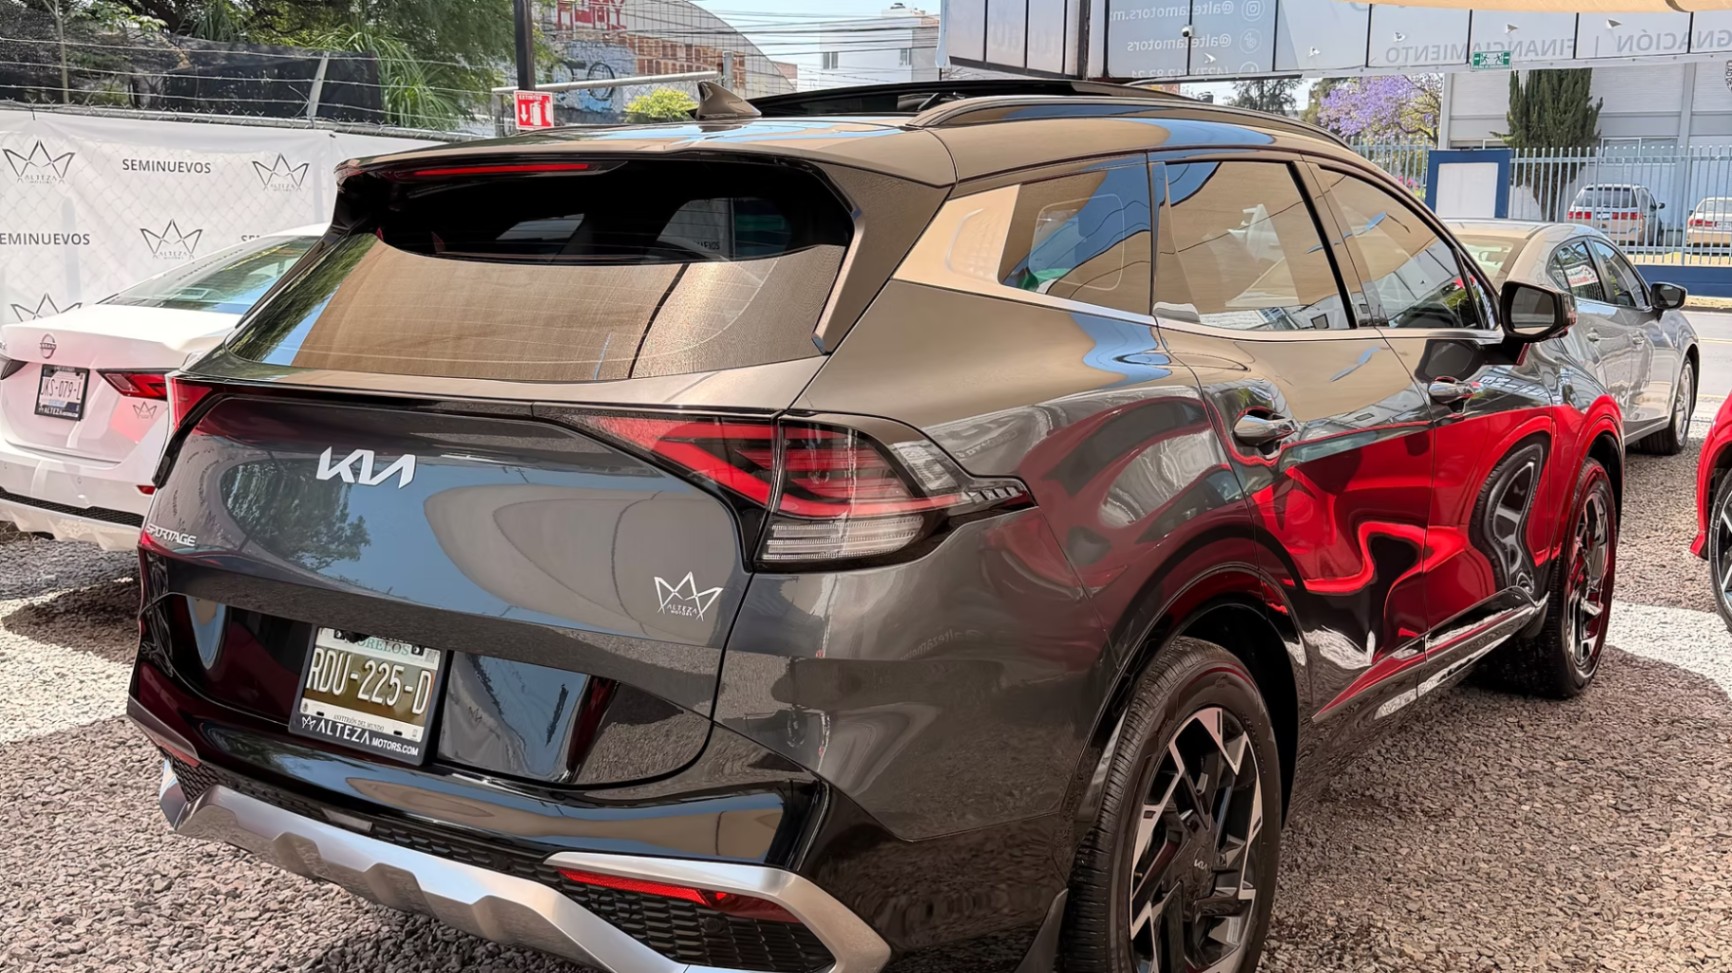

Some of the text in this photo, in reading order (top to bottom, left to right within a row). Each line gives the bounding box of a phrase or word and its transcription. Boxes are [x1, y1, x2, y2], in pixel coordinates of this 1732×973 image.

[122, 158, 211, 174] SEMINUEVOS
[316, 446, 417, 489] KIA
[667, 604, 698, 614] ALTEZA
[345, 637, 410, 656] ORELOS
[306, 647, 432, 715] RDU-225-D
[316, 719, 370, 745] ALTEZA
[371, 737, 419, 756] MOTORS.COM
[1193, 859, 1208, 870] KIA
